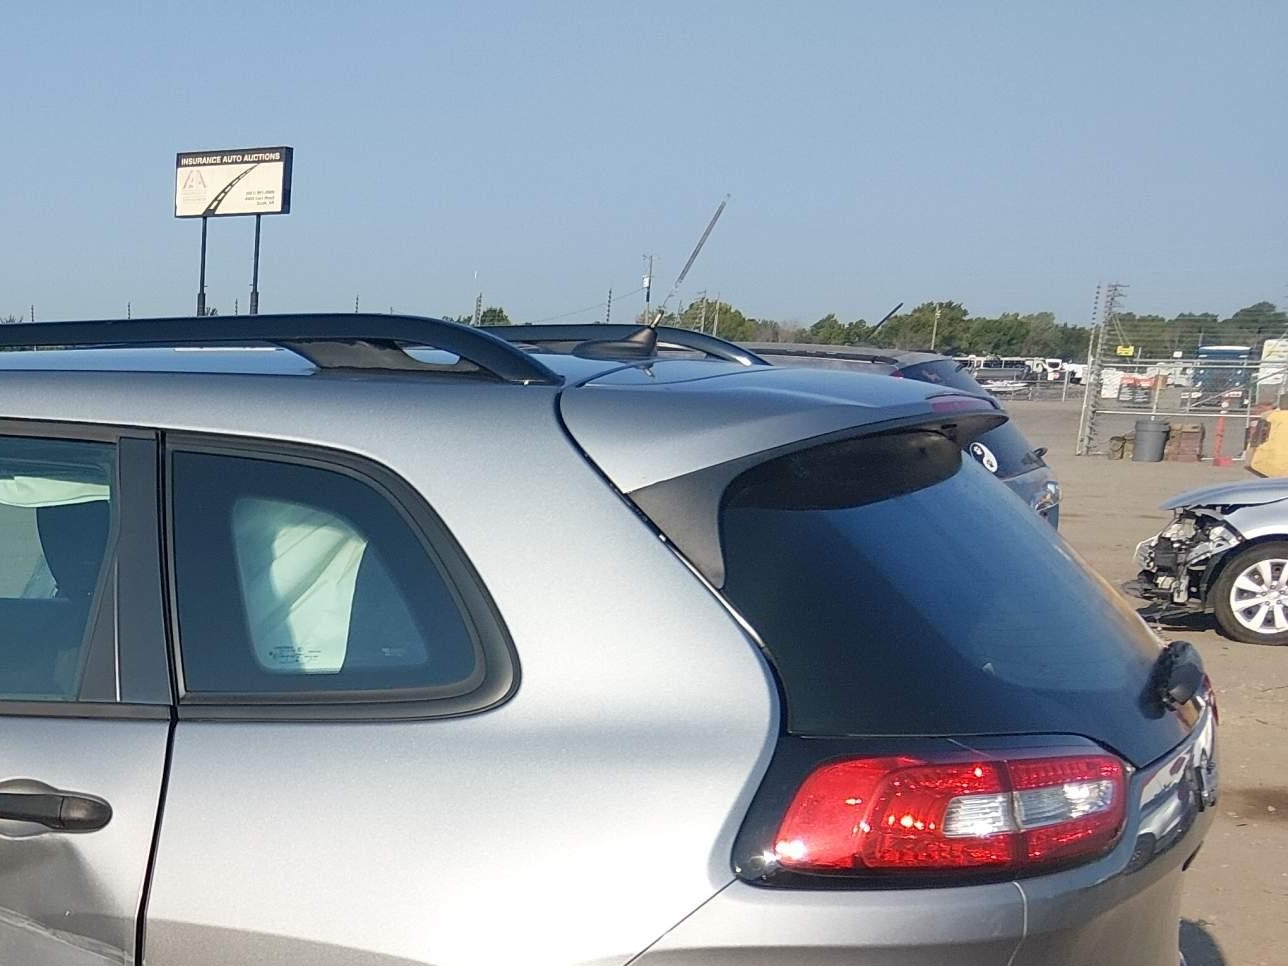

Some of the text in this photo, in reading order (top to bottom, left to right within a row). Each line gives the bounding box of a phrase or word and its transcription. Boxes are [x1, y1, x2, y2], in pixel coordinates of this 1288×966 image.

[181, 152, 280, 166] INSURANCE AUTO AUCTIONS
